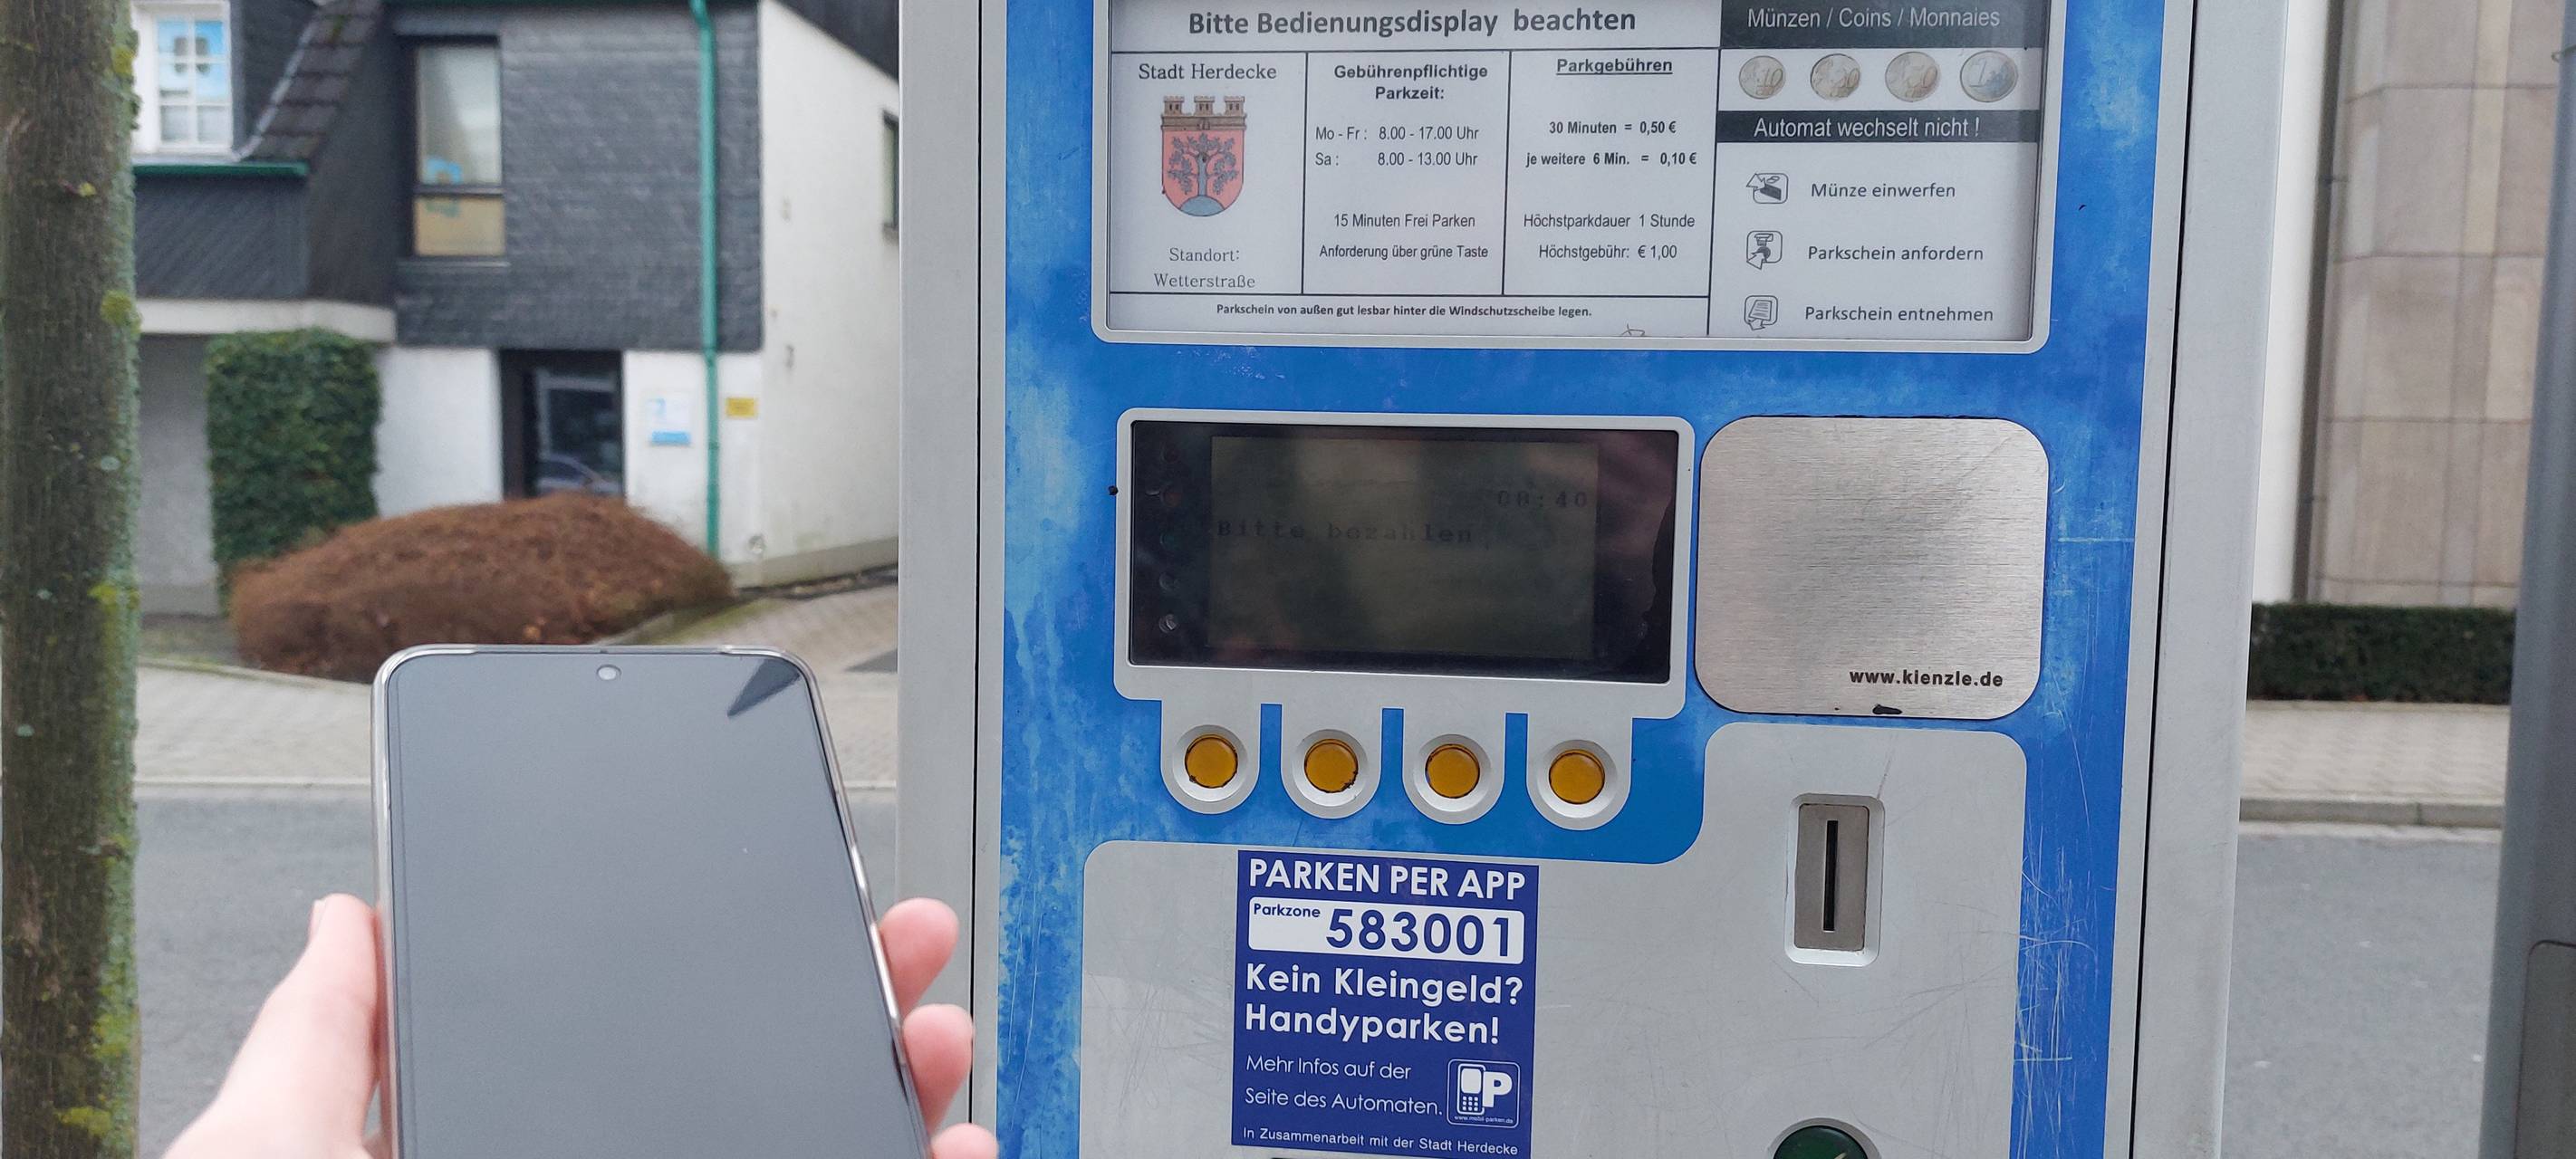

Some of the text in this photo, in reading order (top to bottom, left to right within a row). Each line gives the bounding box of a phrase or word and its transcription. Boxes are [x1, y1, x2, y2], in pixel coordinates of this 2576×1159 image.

[1189, 8, 1636, 38] Bitte Bedienungsdisplay beachten
[1748, 7, 2001, 29] Münzen / Coins / Monnaies
[1139, 63, 1277, 80] Stadt Herdecke
[1333, 64, 1488, 81] Gebührenpflichtige
[1556, 58, 1674, 76] Parkgebühren
[1375, 86, 1445, 100] Parkzeit:
[1315, 127, 1335, 140] Mo
[1347, 127, 1360, 140] Fr
[1379, 127, 1406, 140] 8.00
[1419, 126, 1453, 140] 17.00
[1456, 127, 1479, 140] Uhr
[1549, 121, 1563, 134] 30
[1567, 121, 1617, 134] Minuten
[1639, 121, 1666, 136] 0,50
[1668, 121, 1677, 134] €
[1754, 117, 1980, 138] Automat wechselt nicht !
[1315, 152, 1331, 166] Sa
[1377, 152, 1405, 166] 8.00
[1418, 152, 1452, 166] 13.00
[1455, 152, 1478, 166] Uhr
[1525, 153, 1537, 168] je
[1541, 153, 1586, 166] weitere
[1592, 153, 1600, 165] 6
[1604, 152, 1630, 166] Min.
[1659, 153, 1686, 168] 0,10
[1688, 152, 1697, 165] €
[1811, 183, 1956, 197] Münze einwerfen
[1334, 214, 1475, 227] 15 Minuten Frei Parken
[1523, 214, 1696, 231] Höchstparkdauer 1 Stunde
[1168, 248, 1240, 262] Standort:
[1319, 244, 1489, 261] Anforderung über grüne Taste
[1539, 244, 1677, 262] Höchstgebühr: € 1,00
[1808, 245, 1984, 261] Parkschein anfordern
[1153, 273, 1255, 288] Wetterstraße
[1216, 304, 1592, 319] Parkschein von außen gut lesbar hinter die Windschutzscheibe legen.
[1805, 306, 1994, 321] Parkschein entnehmen
[1216, 519, 1306, 539] Bitte
[1850, 669, 2003, 686] www.kienzle.de
[1250, 859, 1524, 899] PARKEN PER APP
[1254, 904, 1321, 917] Parkzone
[1325, 908, 1510, 957] 583001
[1247, 963, 1523, 1006] Kein Kleingeld?
[1246, 1003, 1500, 1044] Handyparken!
[1247, 1056, 1411, 1078] Mehr Infos auf der
[1245, 1088, 1442, 1115] Seite des Automaten.
[1244, 1127, 1517, 1154] In Zusammenarbeit mit der Stadt Herdecke
